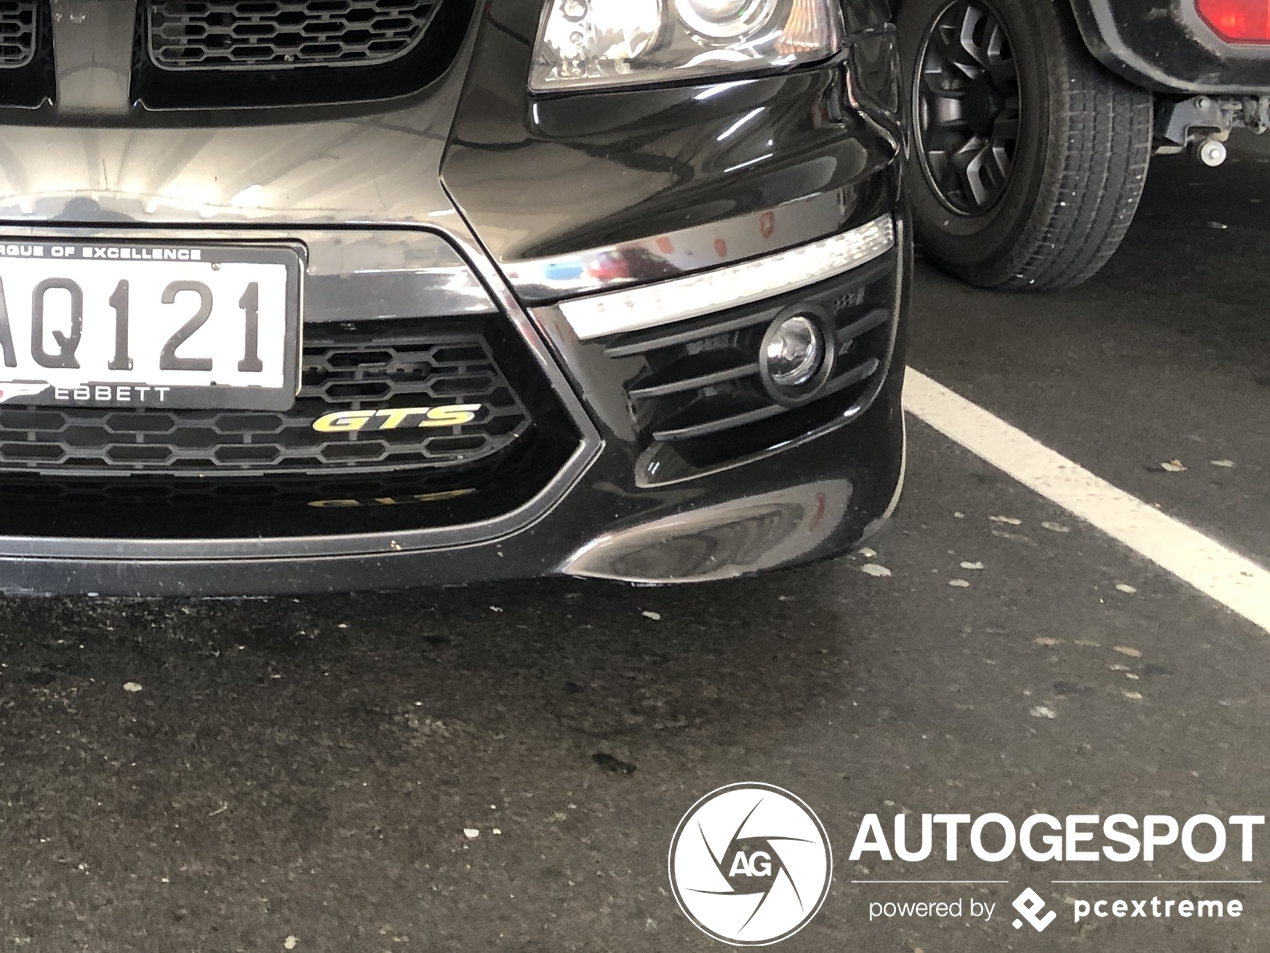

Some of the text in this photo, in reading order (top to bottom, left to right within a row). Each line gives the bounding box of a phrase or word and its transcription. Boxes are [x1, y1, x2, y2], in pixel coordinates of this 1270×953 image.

[50, 245, 75, 258] OF
[81, 246, 202, 261] EXCELLENCE
[54, 385, 171, 402] EBBETT
[312, 403, 482, 433] GTS
